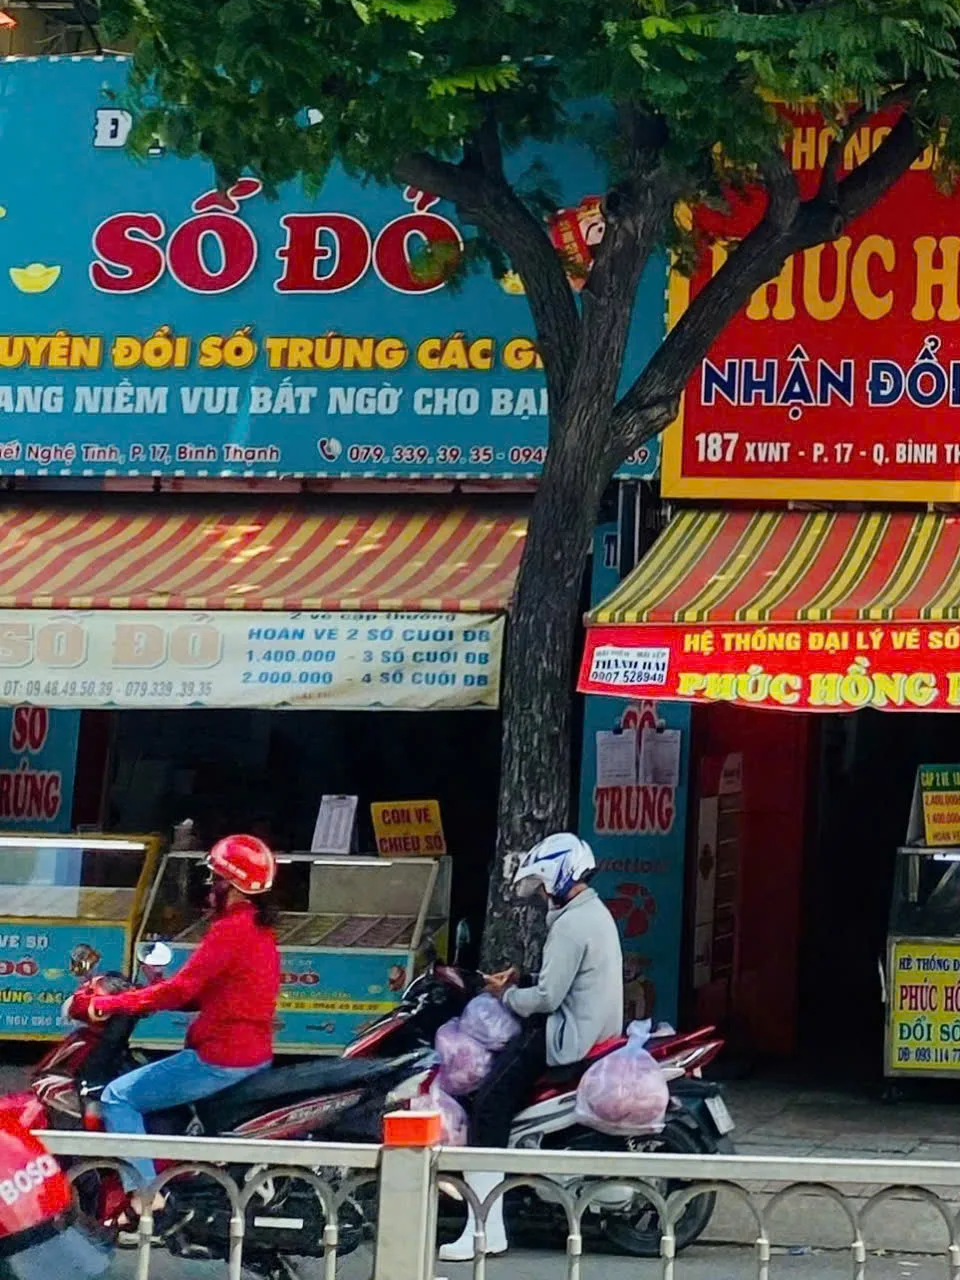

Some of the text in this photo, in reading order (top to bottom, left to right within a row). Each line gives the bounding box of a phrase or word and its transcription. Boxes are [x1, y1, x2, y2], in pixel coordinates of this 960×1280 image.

[89, 177, 262, 295] SỐ
[112, 324, 190, 369] ĐỔI
[199, 321, 257, 369] SỐ
[266, 331, 408, 370] TRÚNG
[417, 331, 495, 370] CÁC
[74, 379, 168, 414] NIỀM
[180, 386, 240, 414] VUI
[250, 376, 317, 415] BẤT
[328, 382, 402, 415] NGỜ
[414, 387, 479, 416] CHO
[701, 345, 854, 421] NHẬN
[695, 432, 739, 463] 187
[745, 441, 791, 463] XVNT
[813, 441, 828, 464] P.
[835, 442, 853, 464] 17
[873, 442, 889, 465] Q.
[896, 438, 938, 465] BÌNH
[347, 629, 359, 642] 2
[683, 627, 713, 654] HỆ
[724, 627, 801, 652] THỐNG
[809, 631, 848, 655] ĐẠI
[857, 627, 883, 651] LÝ
[892, 627, 922, 651] VÉ
[928, 625, 960, 650] SỐ
[363, 650, 374, 663] 3
[677, 664, 800, 706] PHÚC
[808, 656, 938, 708] HỒNG
[900, 977, 938, 1011] PHÚC
[898, 1015, 933, 1041] ĐỔI
